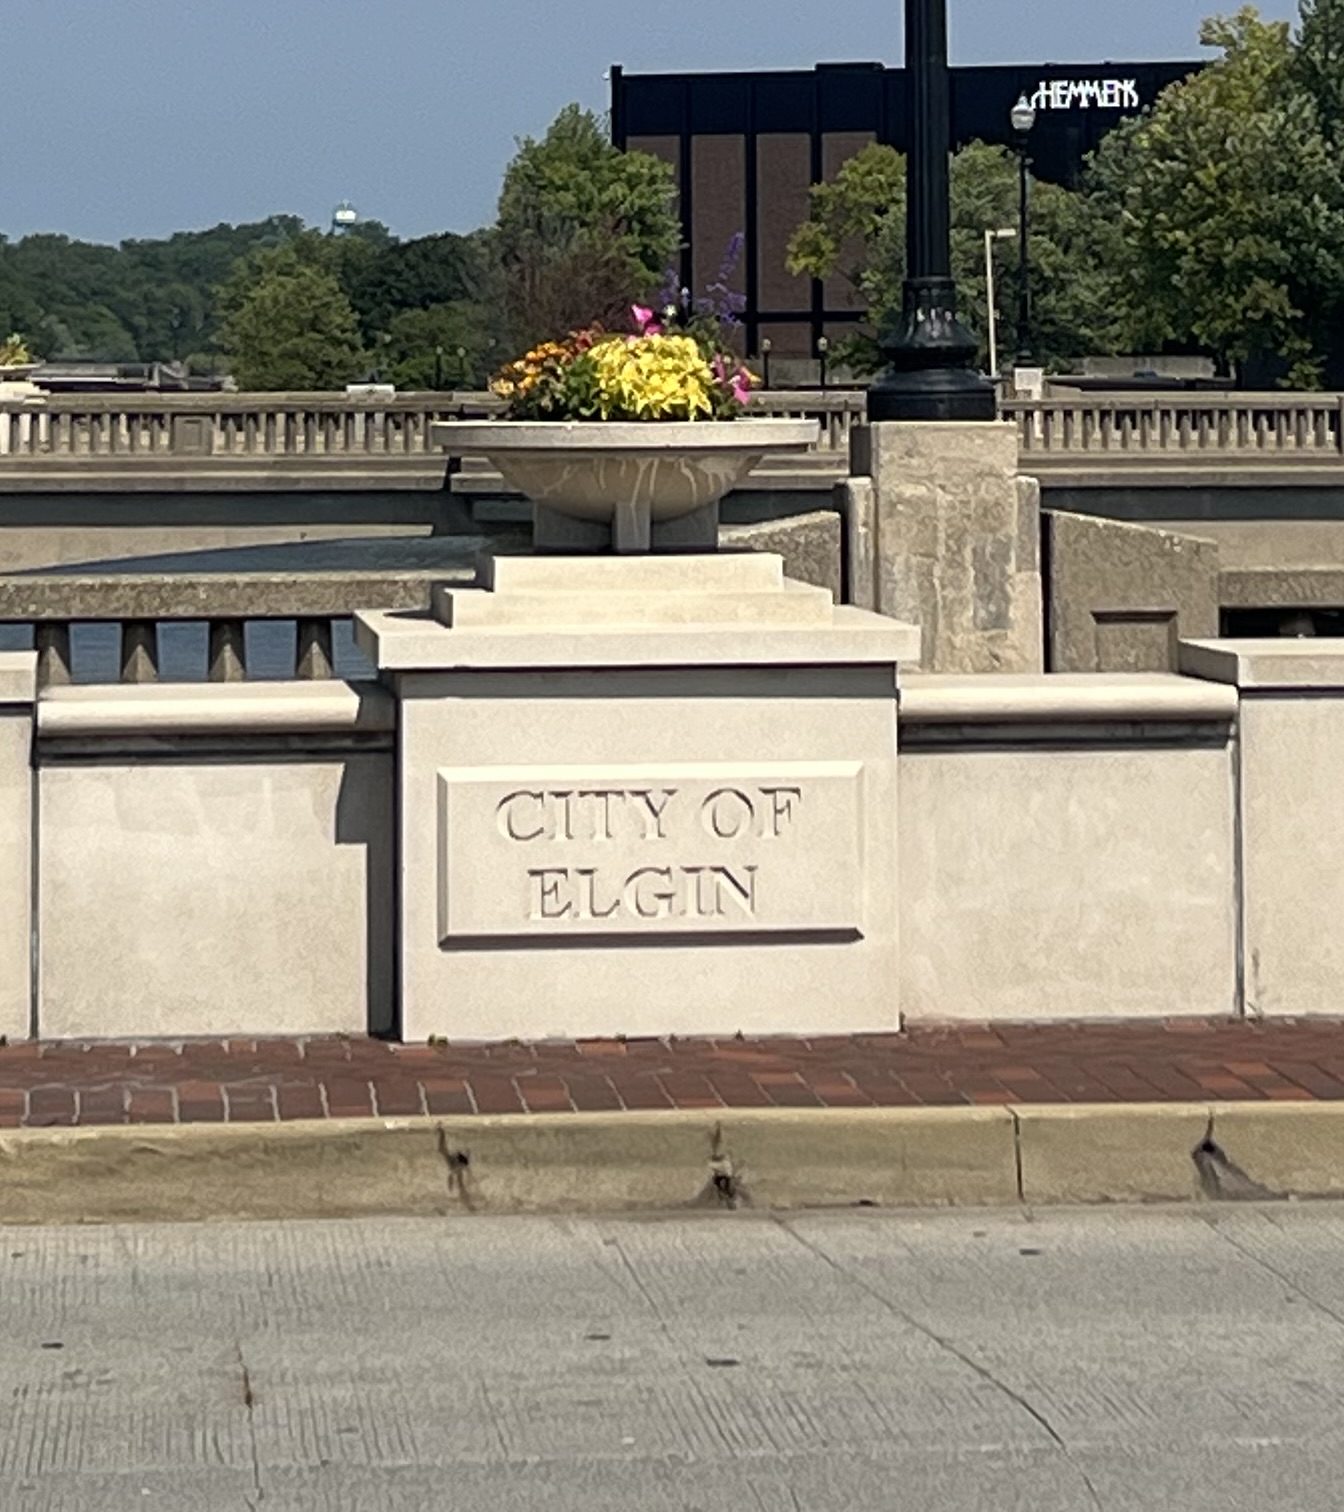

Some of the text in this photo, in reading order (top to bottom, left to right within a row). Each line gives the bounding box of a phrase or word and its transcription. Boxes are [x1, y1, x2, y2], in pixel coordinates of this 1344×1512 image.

[497, 787, 801, 840] CITY OF
[528, 866, 758, 920] ELGIN
